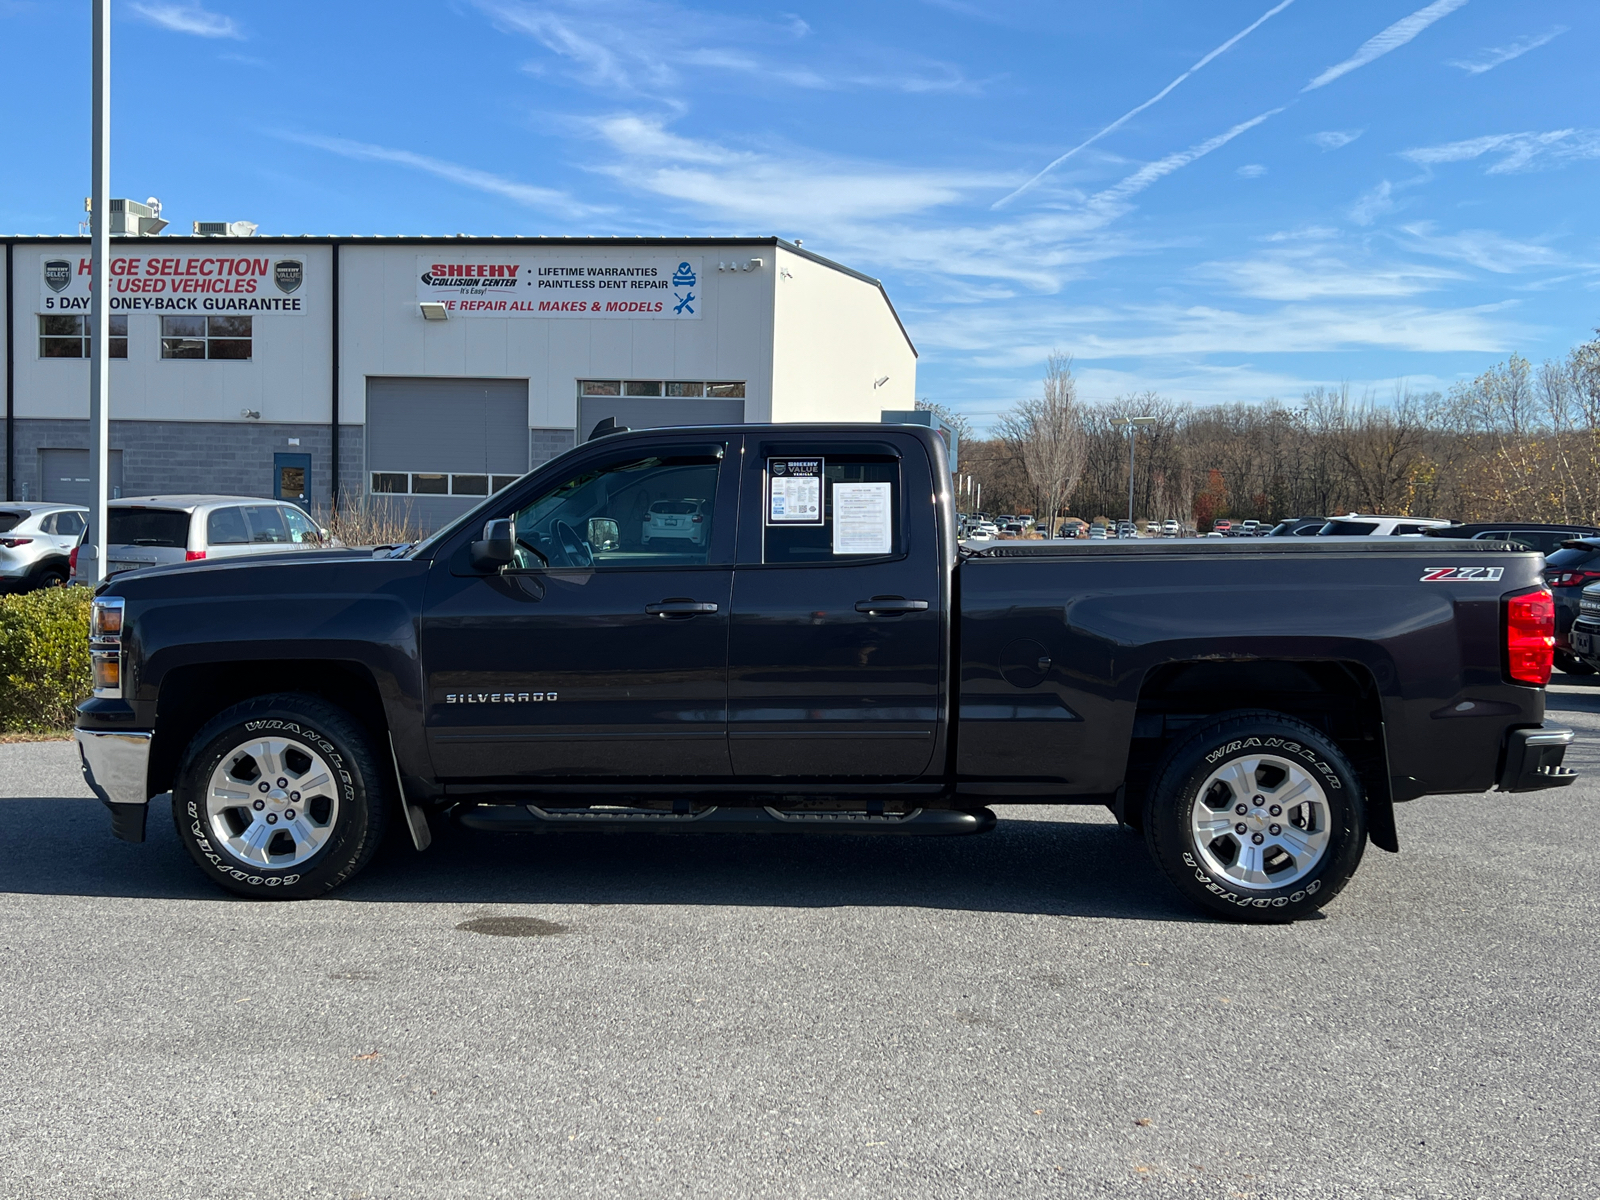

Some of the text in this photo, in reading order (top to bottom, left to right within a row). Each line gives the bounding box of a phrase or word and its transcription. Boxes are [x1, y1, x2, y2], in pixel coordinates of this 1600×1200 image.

[78, 258, 269, 276] HGE SELECTION
[431, 264, 520, 278] SHEEHY
[538, 267, 658, 277] LIFETIME WARRANTIES
[116, 278, 166, 293] USED
[171, 278, 258, 293] VEHICLES
[431, 278, 518, 288] COLLISION CENTER
[538, 280, 668, 289] PAINTLESS DENT REPAIR
[460, 287, 488, 296] It's Easy!
[46, 297, 301, 310] 5 DAY ONEY-BACK GUARANTEE
[460, 300, 508, 311] REPAIR
[509, 301, 534, 311] ALL
[538, 301, 587, 312] MAKES
[591, 301, 602, 312] &
[605, 302, 663, 312] MODELS
[1419, 567, 1505, 581] Z71
[446, 692, 558, 704] SILVERADO
[245, 720, 355, 801] WRANGLER
[1205, 738, 1342, 790] WRANGLER
[188, 801, 300, 887] GOODYEAR
[1182, 852, 1322, 908] GOODYEAR
